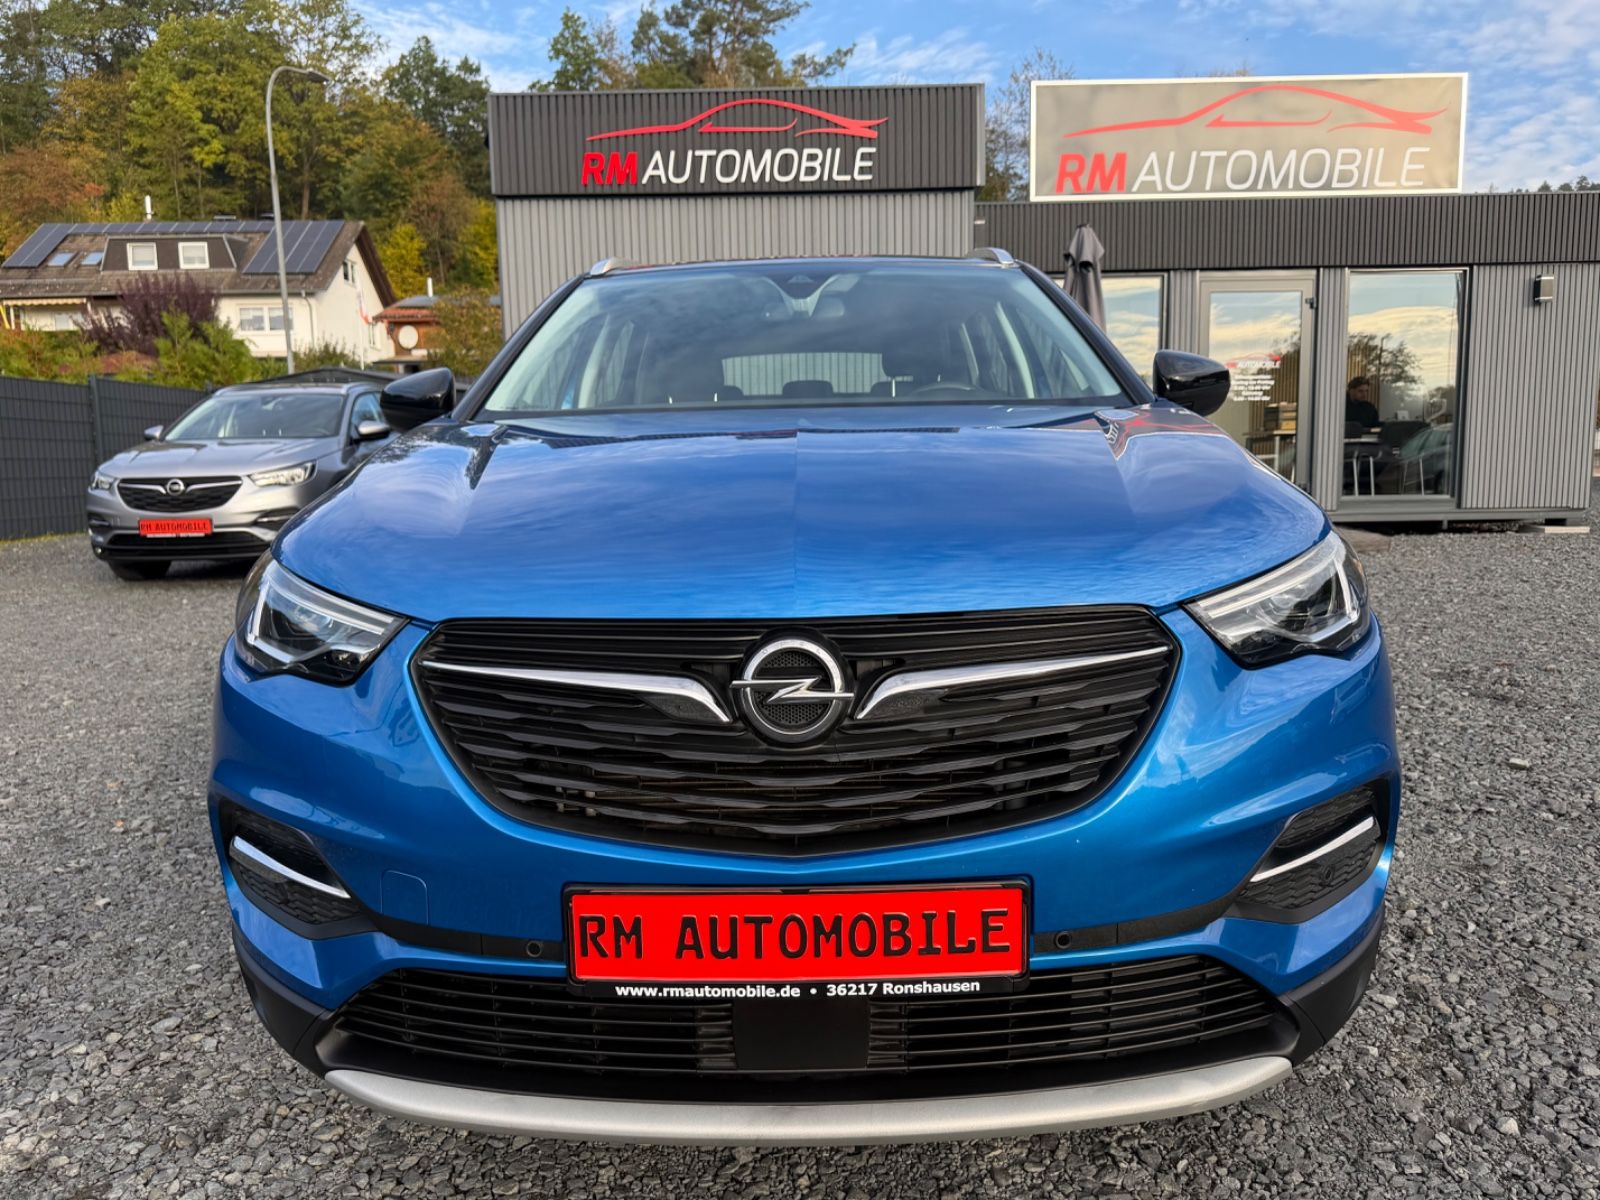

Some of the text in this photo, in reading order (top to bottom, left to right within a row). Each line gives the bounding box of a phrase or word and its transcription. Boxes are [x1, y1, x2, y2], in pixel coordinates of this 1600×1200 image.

[581, 147, 877, 185] RM AUTOMOBILE
[1055, 147, 1431, 193] RM AUTOMOBILE
[578, 908, 1011, 960] RM AUTOMOBILE
[615, 980, 981, 998] www.rmautomobile.de 36217 Ronshausen
